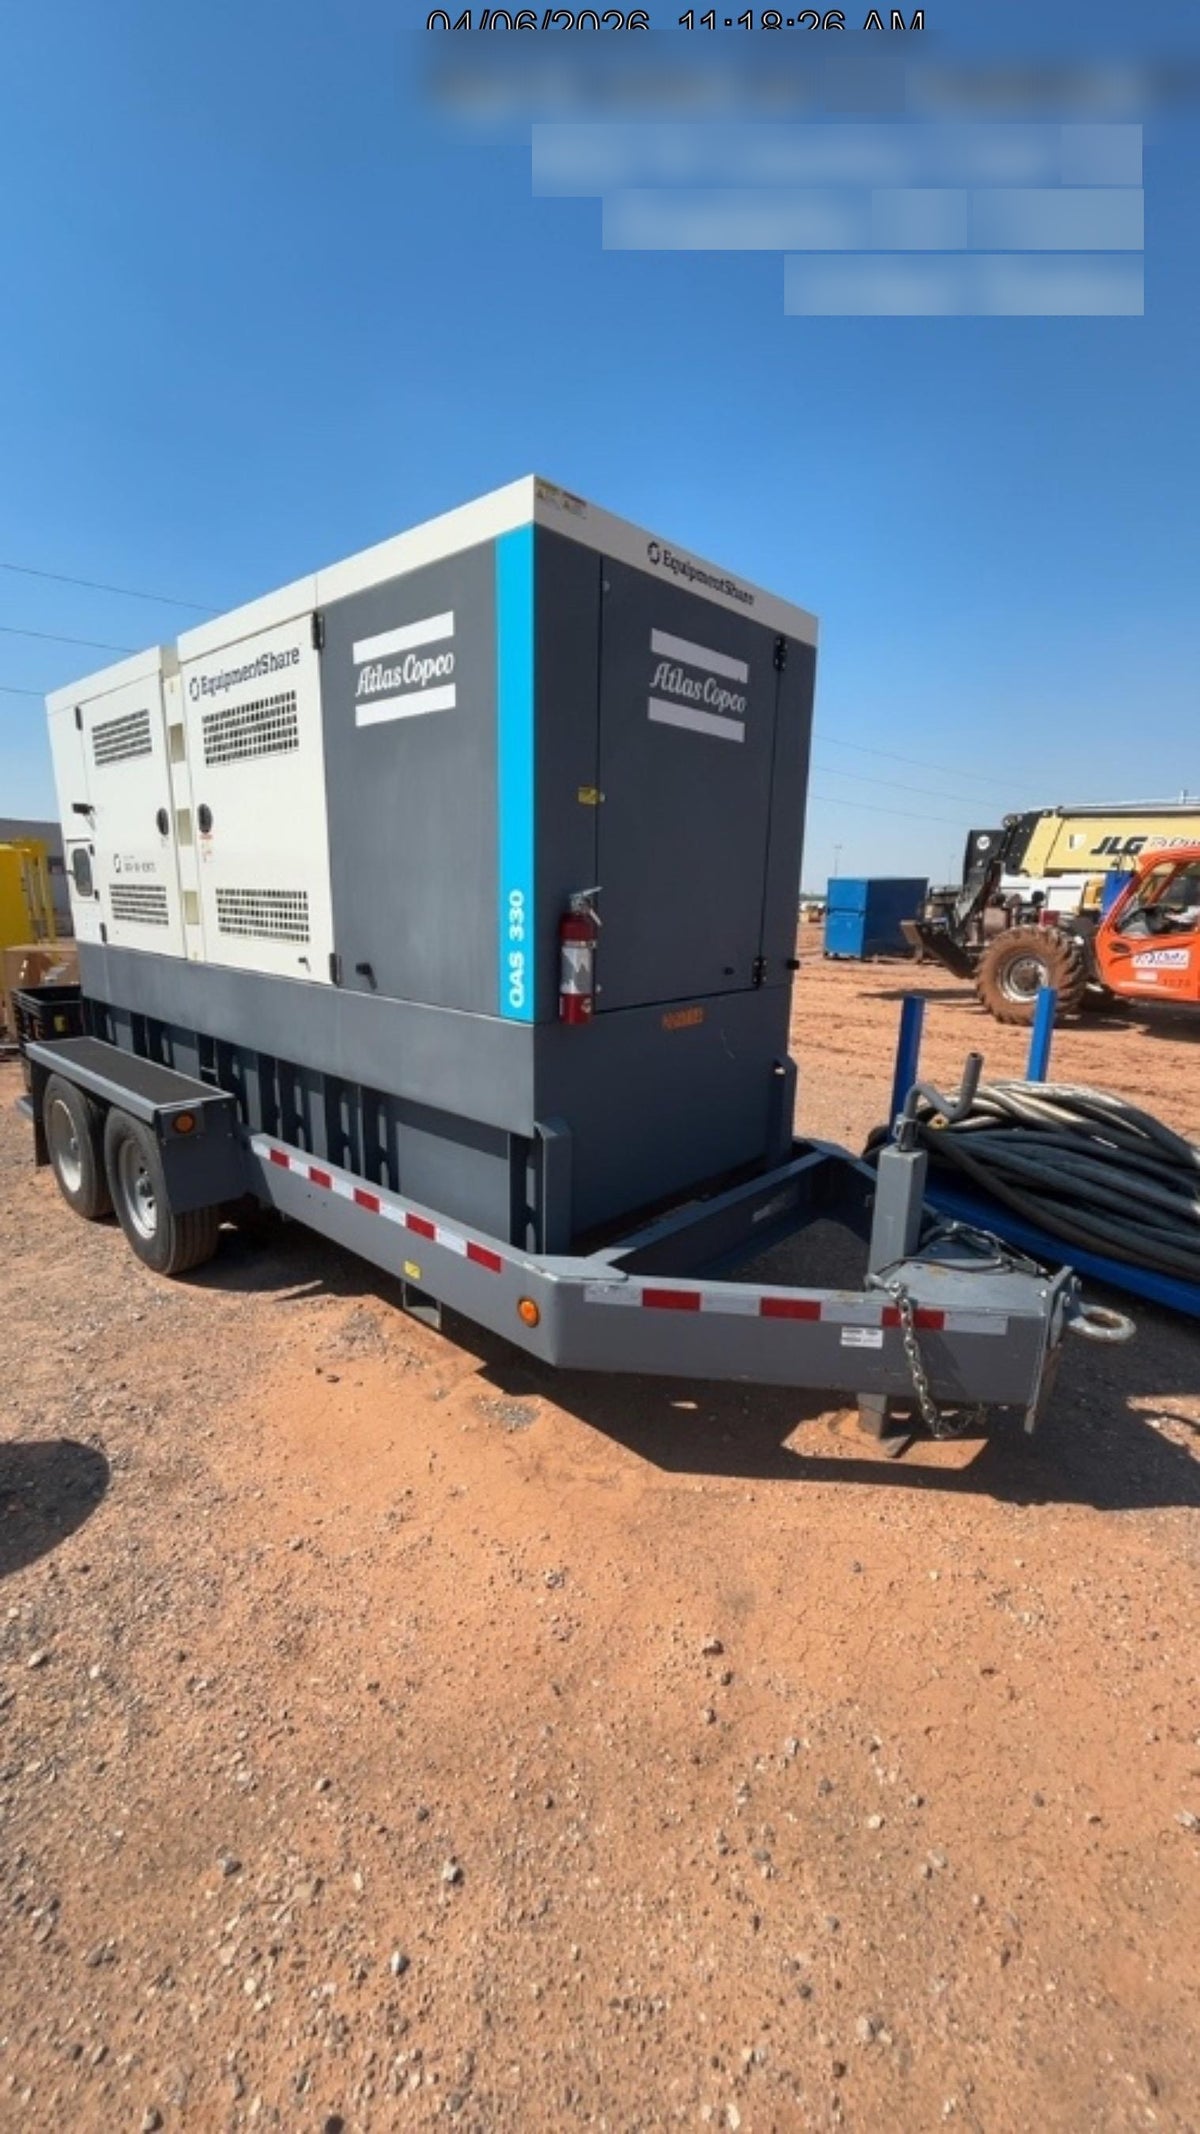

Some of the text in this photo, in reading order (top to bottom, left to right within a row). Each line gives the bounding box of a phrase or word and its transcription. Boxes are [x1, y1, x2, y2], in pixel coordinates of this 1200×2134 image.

[663, 549, 754, 606] EquipmentShare
[200, 646, 300, 698] EquipmentShare
[354, 652, 455, 698] Atlas Copco
[649, 661, 748, 713] Atlas Copco
[1090, 836, 1148, 855] JLG
[508, 889, 525, 1009] QAS 330
